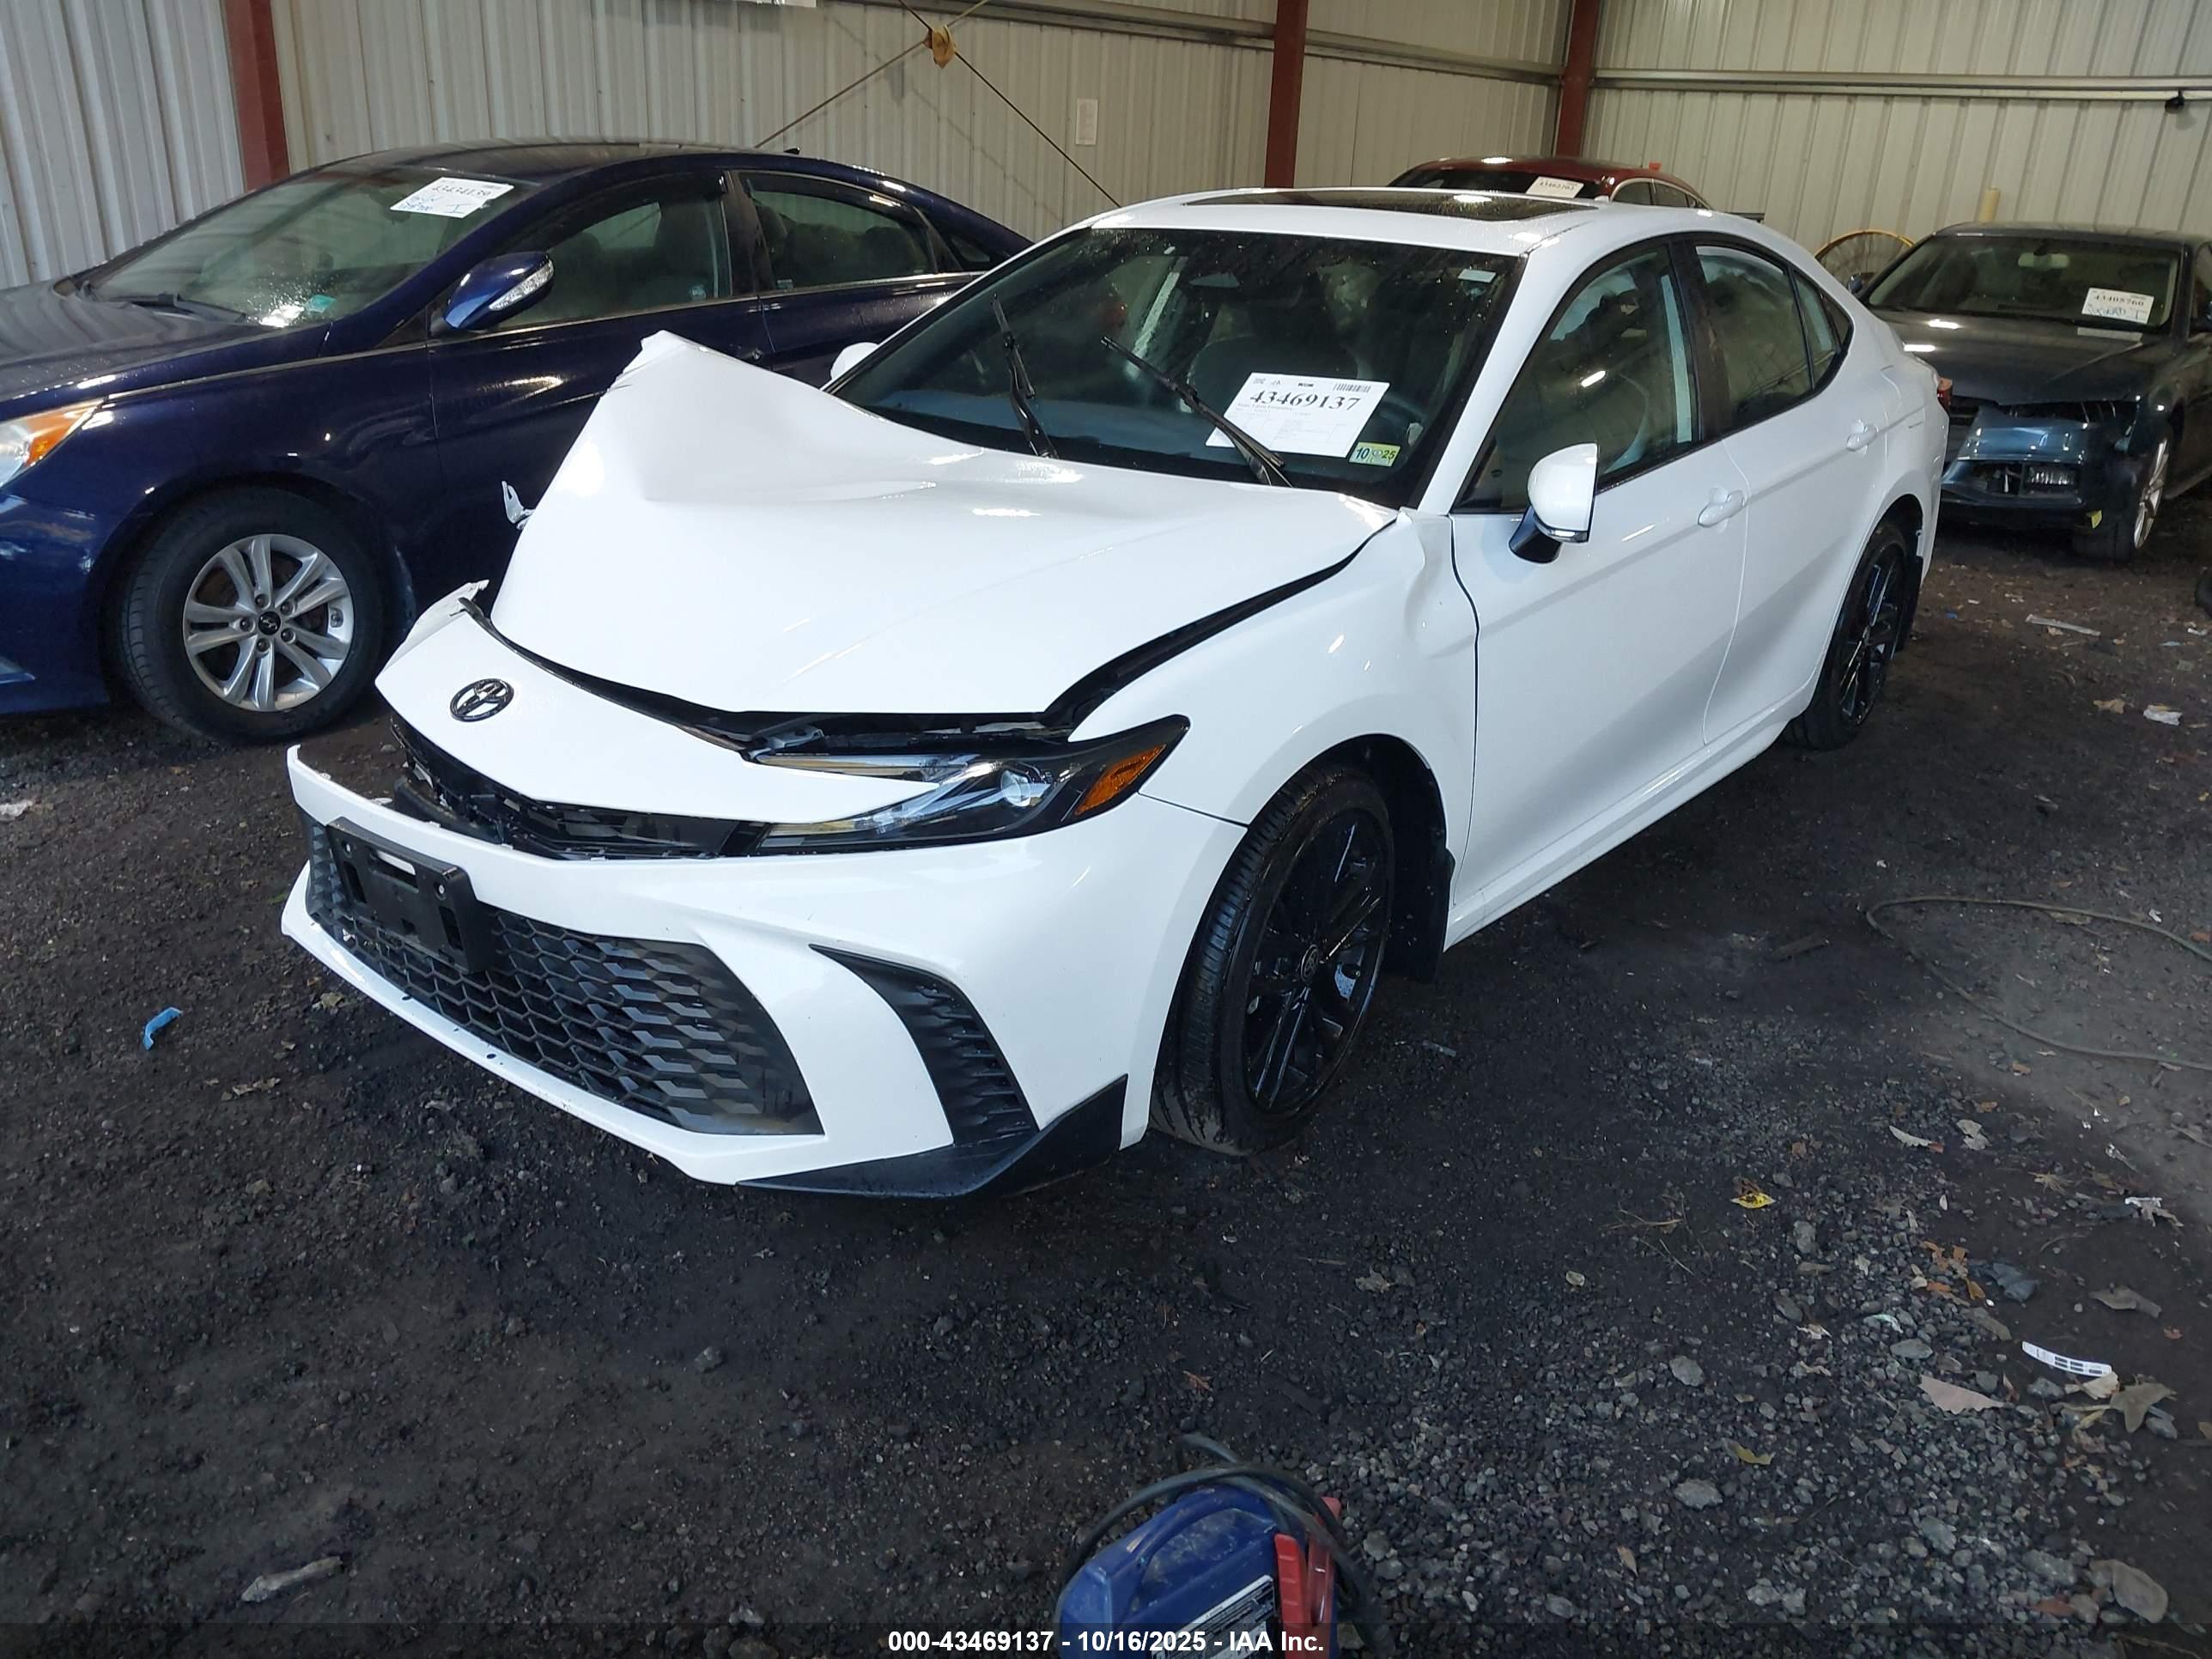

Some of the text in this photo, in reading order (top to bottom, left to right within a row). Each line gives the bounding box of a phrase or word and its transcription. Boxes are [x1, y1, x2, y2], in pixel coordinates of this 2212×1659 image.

[1250, 389, 1362, 411] 43469137
[1356, 447, 1397, 460] 10 25
